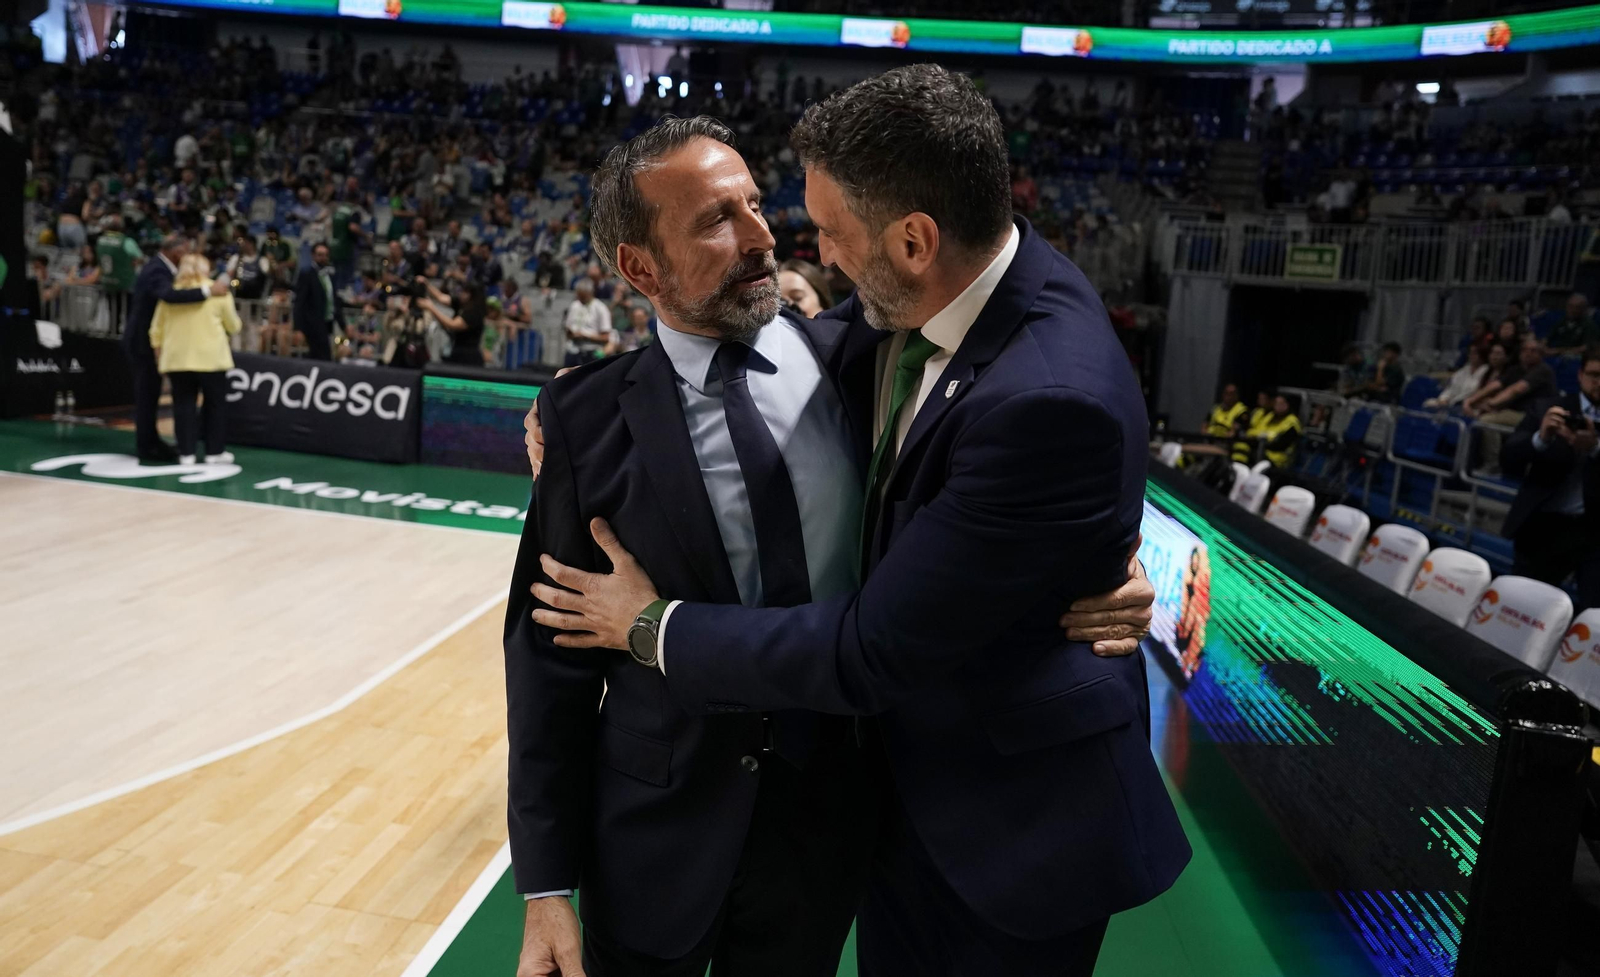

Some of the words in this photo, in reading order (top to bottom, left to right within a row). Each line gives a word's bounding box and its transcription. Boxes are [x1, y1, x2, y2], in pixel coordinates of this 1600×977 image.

[631, 12, 689, 31] PARTIDO
[690, 16, 758, 35] DEDICADO
[758, 20, 772, 35] A
[1168, 39, 1235, 56] PARTIDO
[1237, 39, 1315, 56] DEDICADO
[1318, 39, 1333, 54] A
[225, 366, 411, 421] endesa
